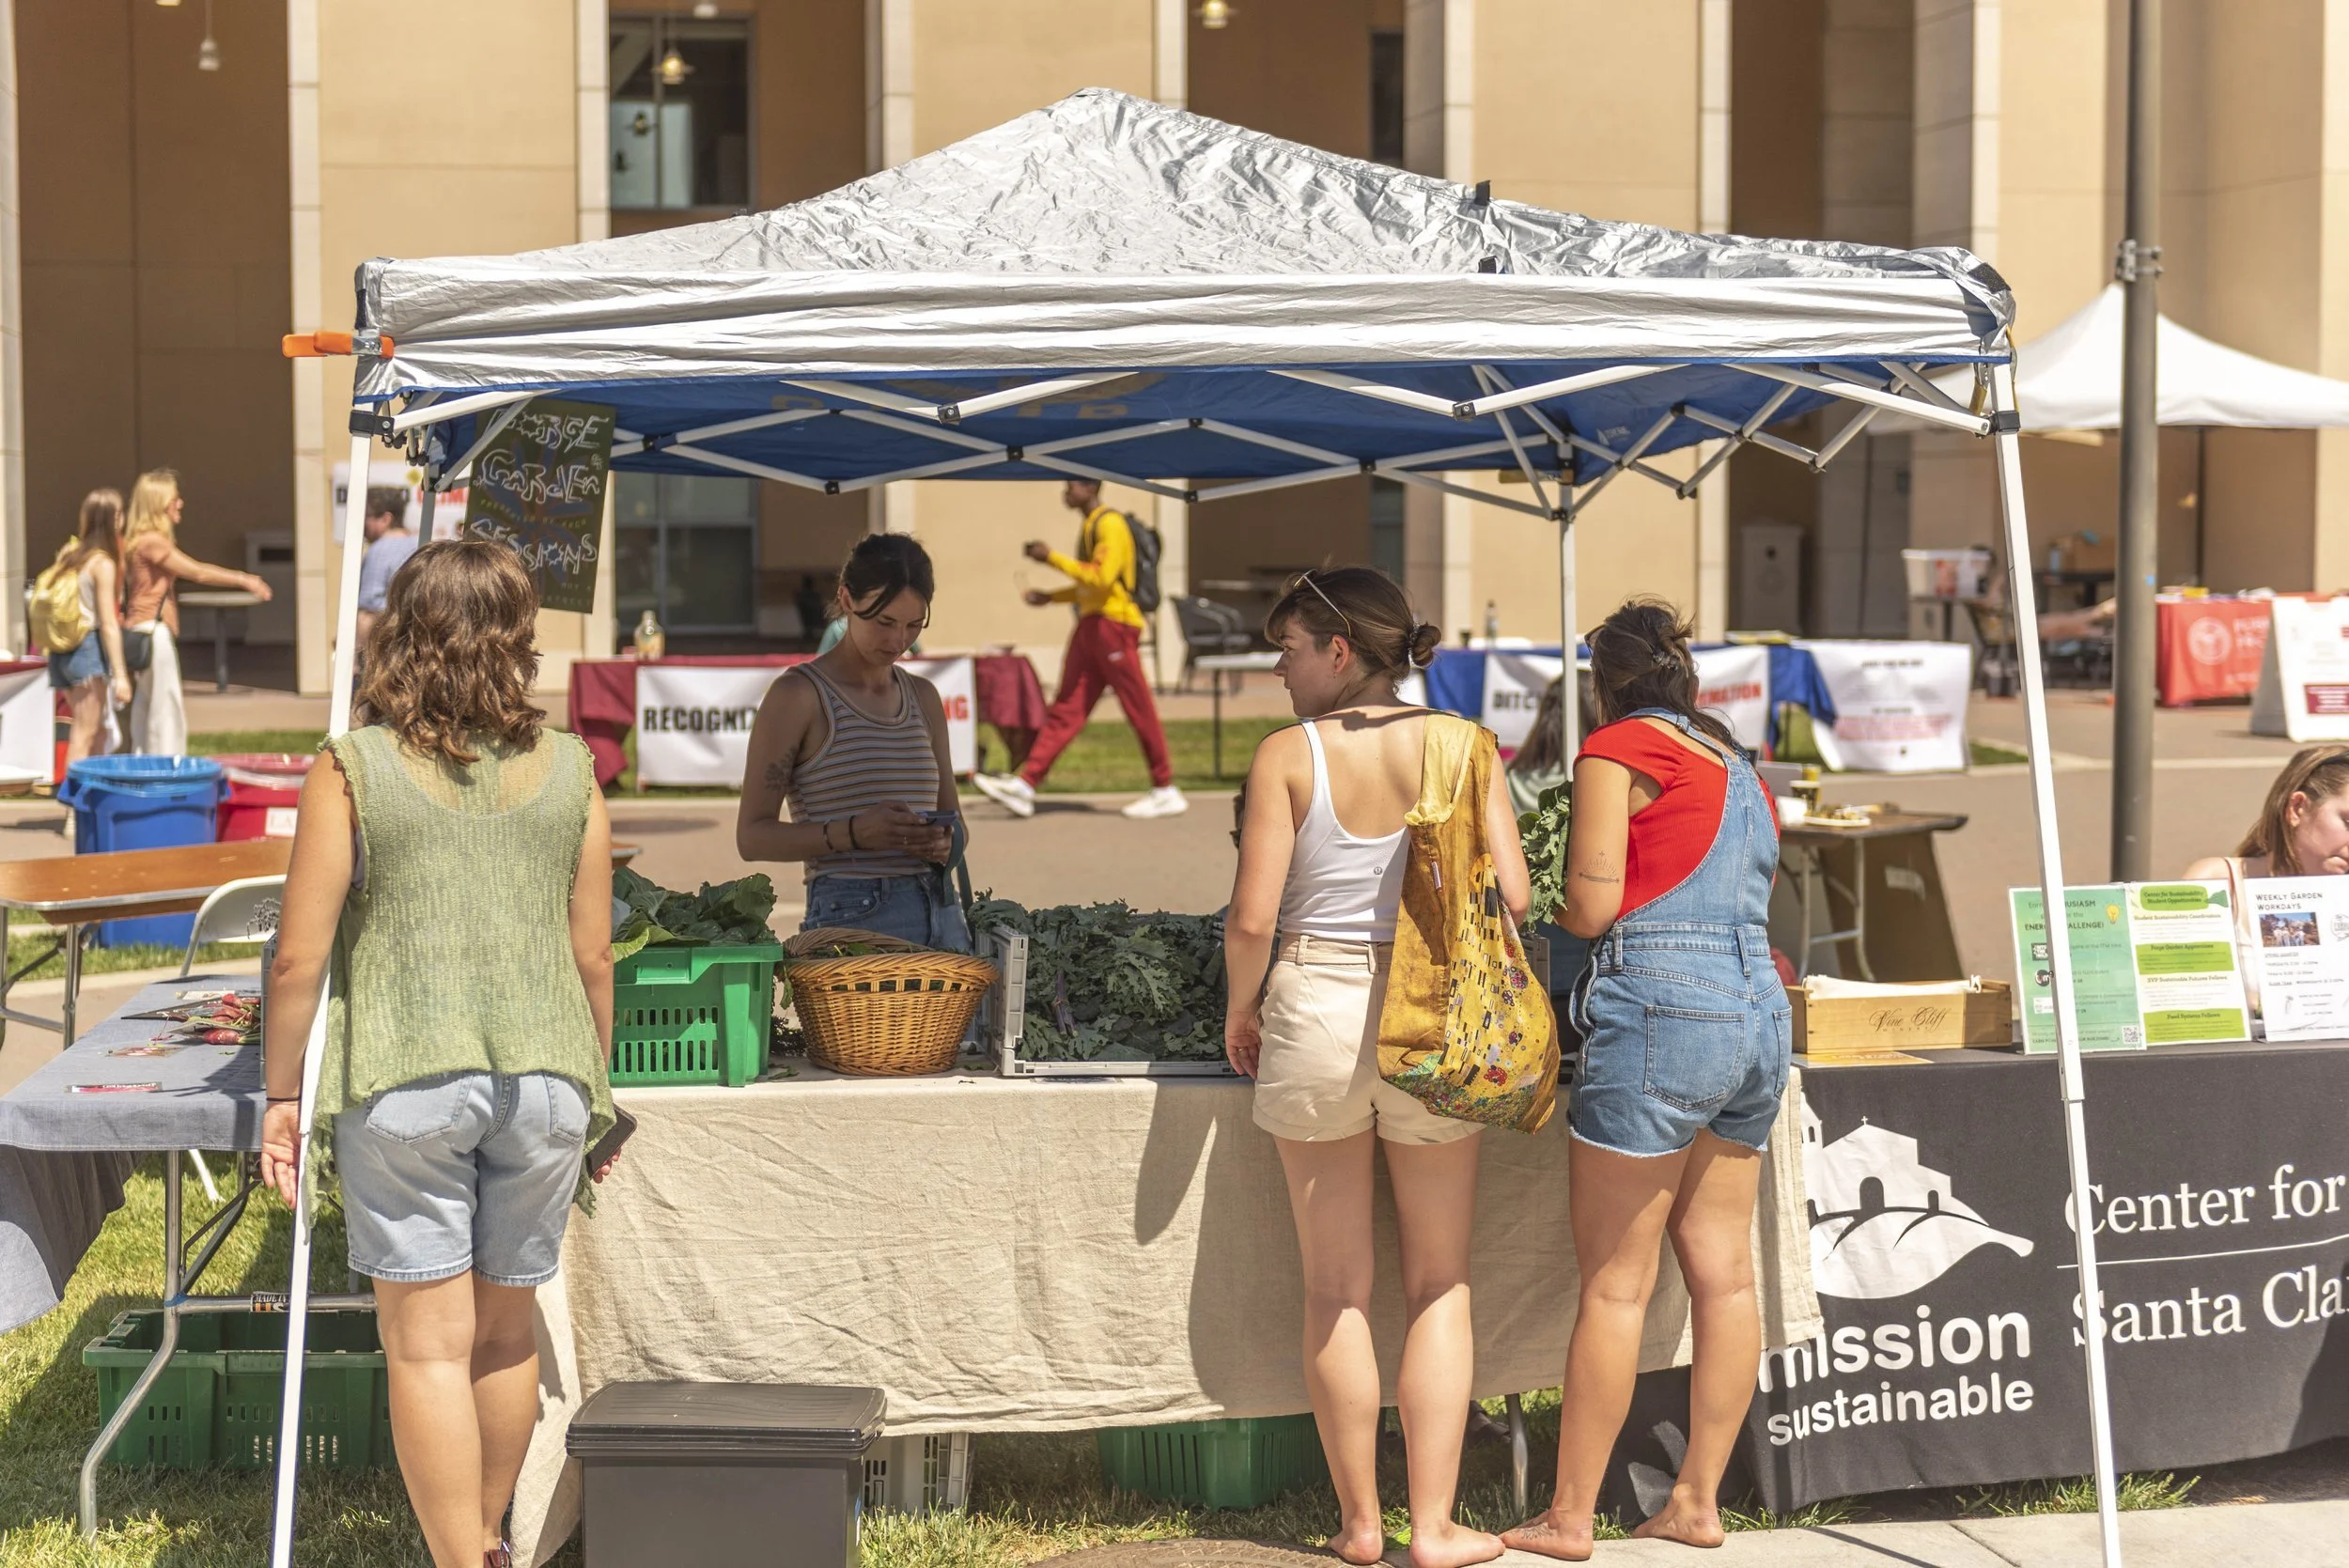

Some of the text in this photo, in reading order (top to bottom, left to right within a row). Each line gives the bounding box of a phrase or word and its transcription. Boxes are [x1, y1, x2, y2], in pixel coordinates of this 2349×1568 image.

[2065, 900, 2096, 908] USIASM
[2068, 922, 2105, 930] ALLENGE!
[2268, 1164, 2346, 1220] for
[2263, 1265, 2349, 1328] Cla
[1766, 1373, 2034, 1447] sustainable
